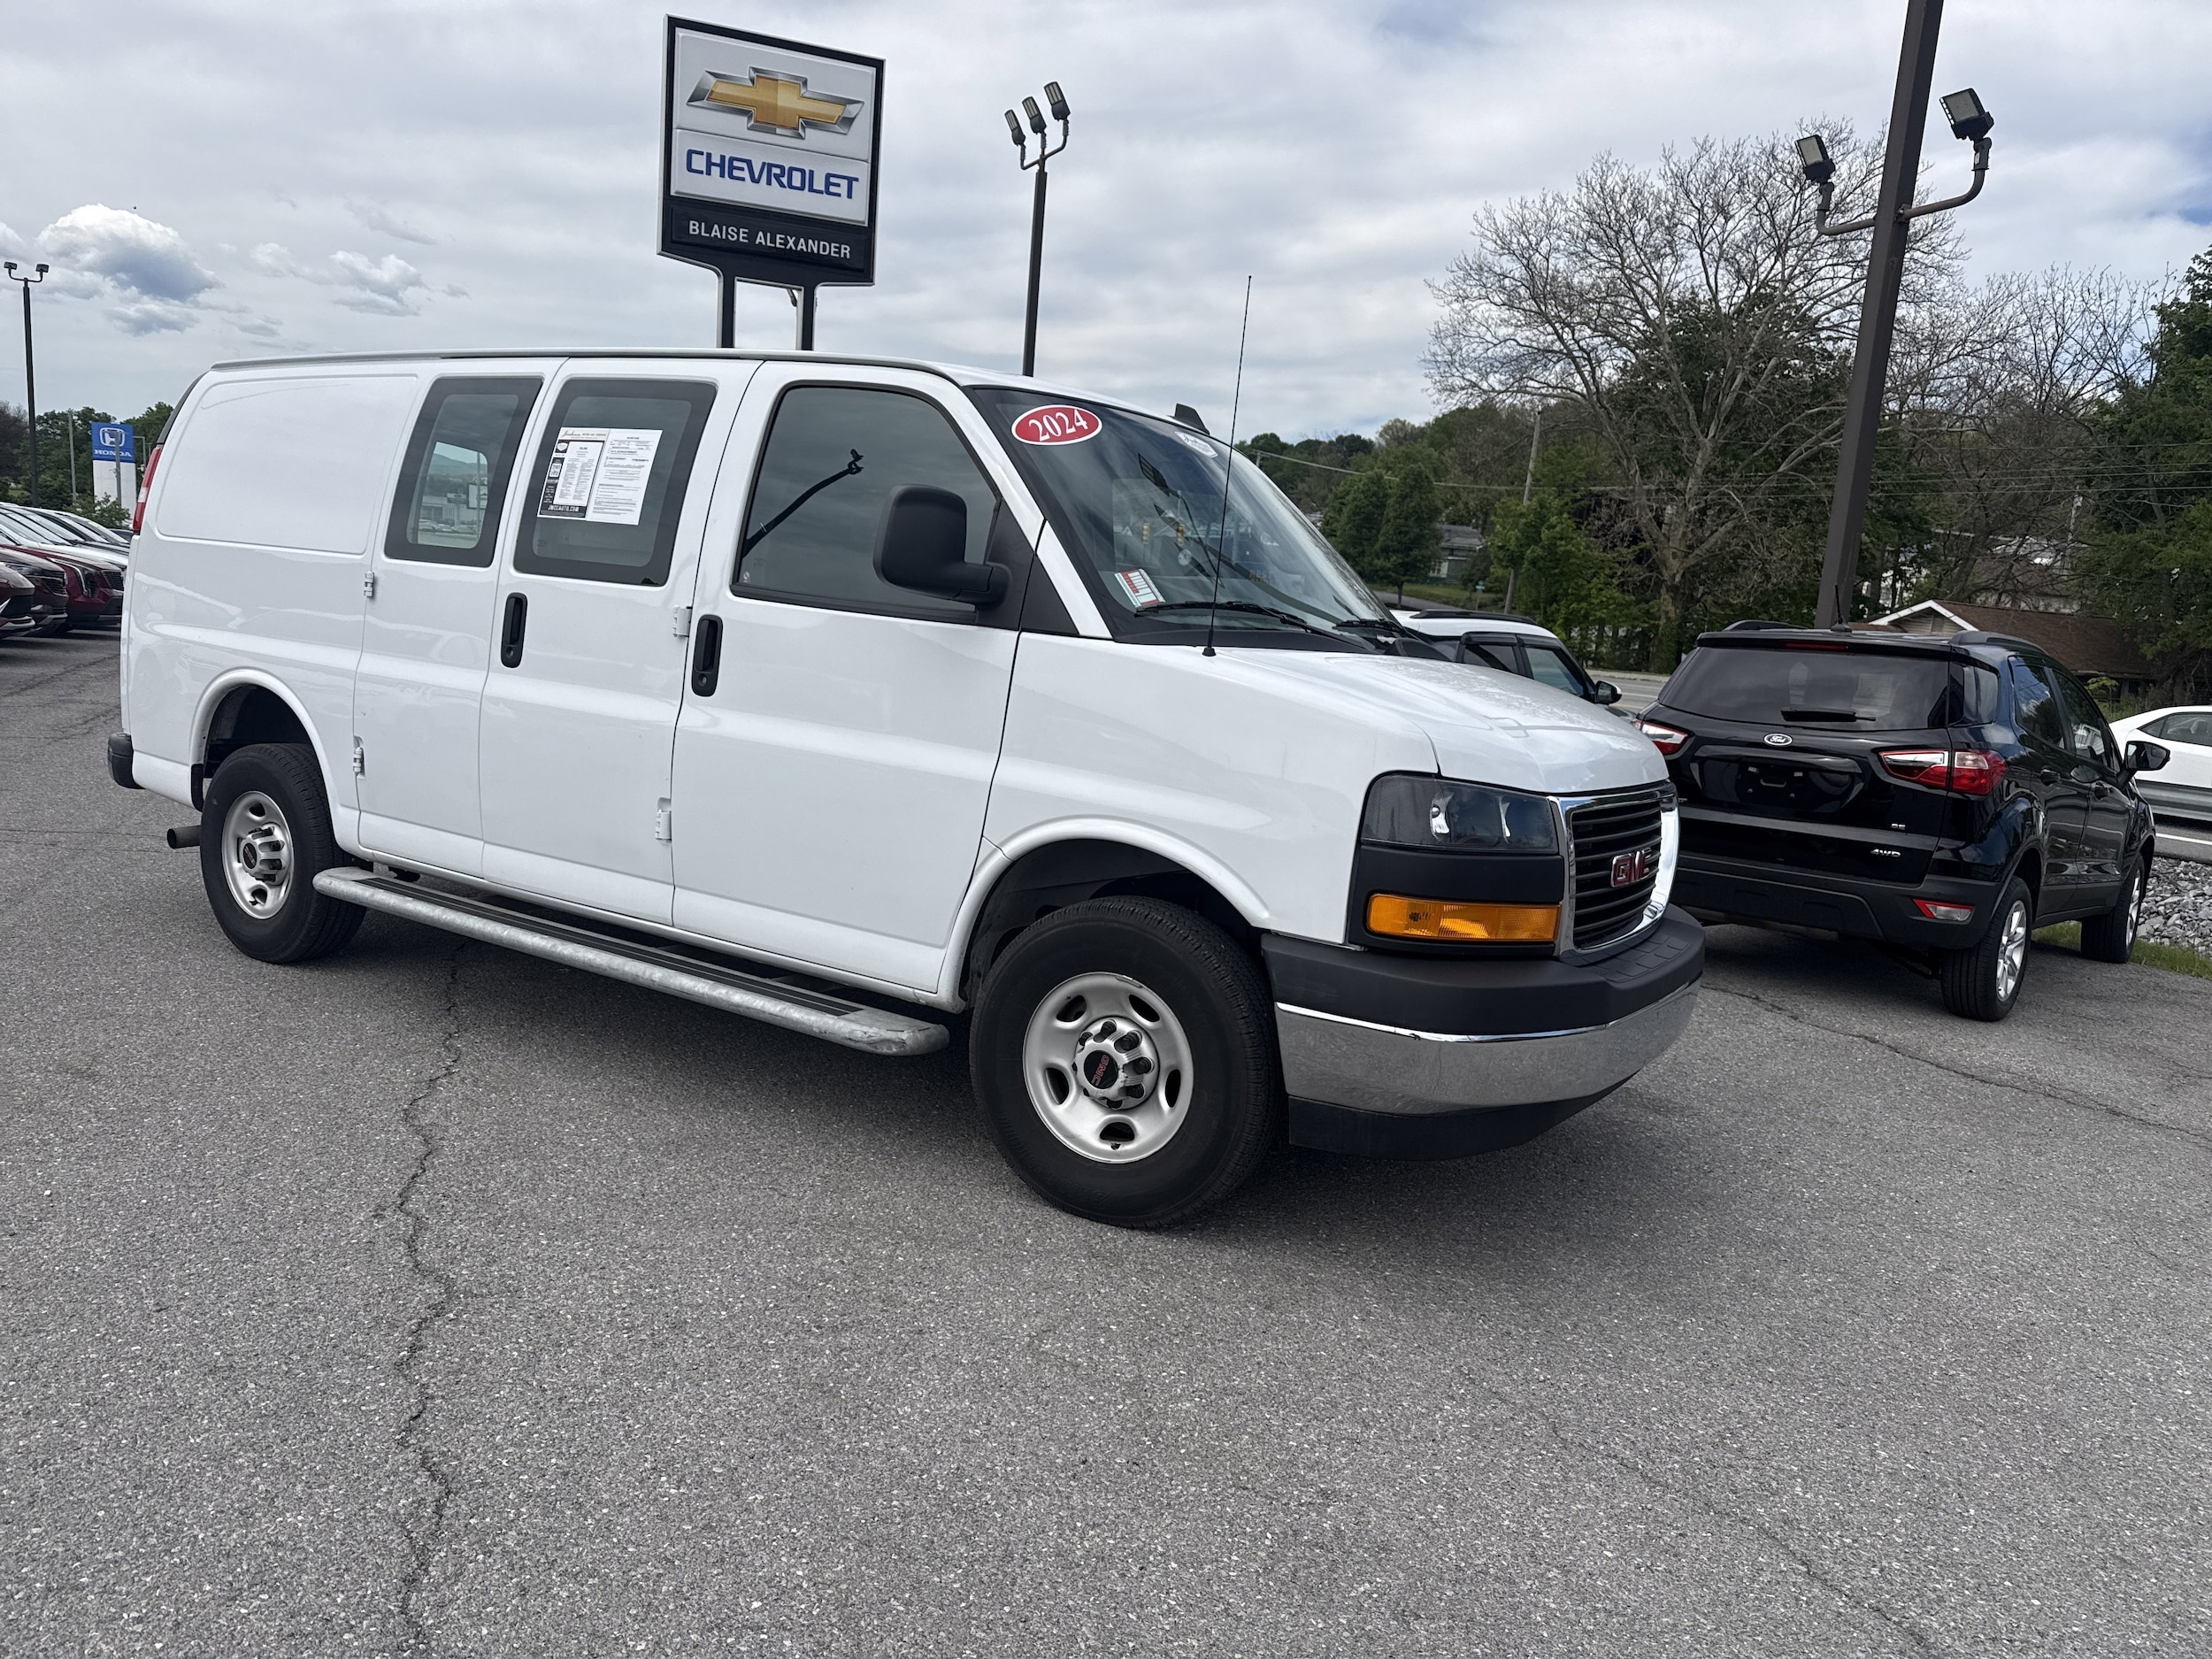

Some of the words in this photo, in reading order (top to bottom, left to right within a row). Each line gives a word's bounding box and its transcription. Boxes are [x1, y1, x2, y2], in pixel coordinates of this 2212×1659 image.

[686, 149, 859, 199] CHEVROLET
[688, 220, 749, 243] BLAISE
[755, 231, 851, 259] ALEXANDER
[1028, 409, 1088, 442] 2024
[1611, 847, 1652, 887] GMC
[1870, 849, 1901, 857] 4WD
[1091, 1054, 1110, 1087] GMC
